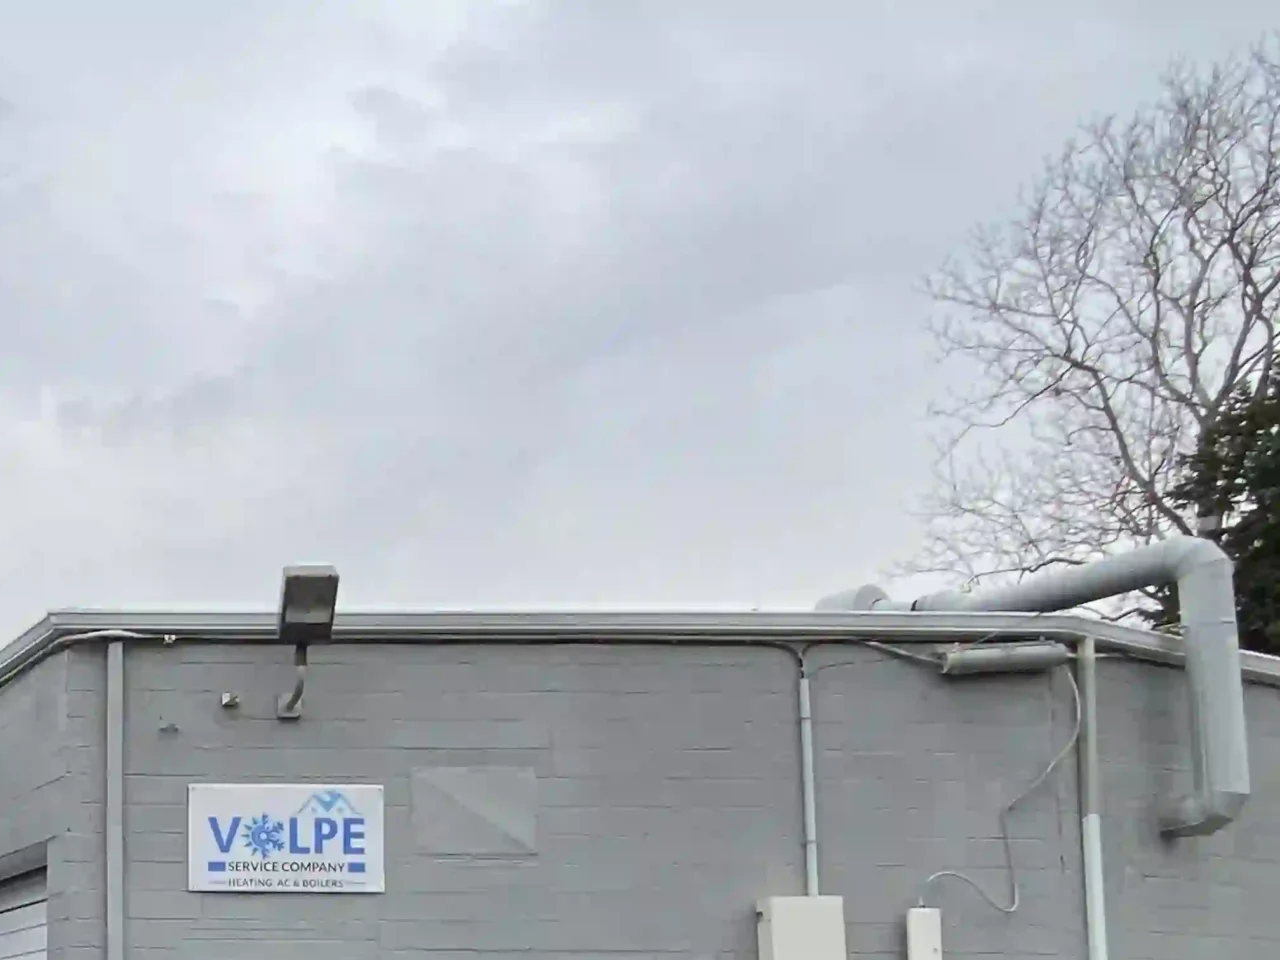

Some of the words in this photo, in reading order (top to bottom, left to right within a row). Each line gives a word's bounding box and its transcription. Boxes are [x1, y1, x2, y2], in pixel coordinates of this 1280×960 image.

[228, 861, 279, 872] SERVICE
[282, 862, 345, 873] COMPANY
[277, 879, 290, 887] AC
[303, 879, 344, 888] BOILERS
